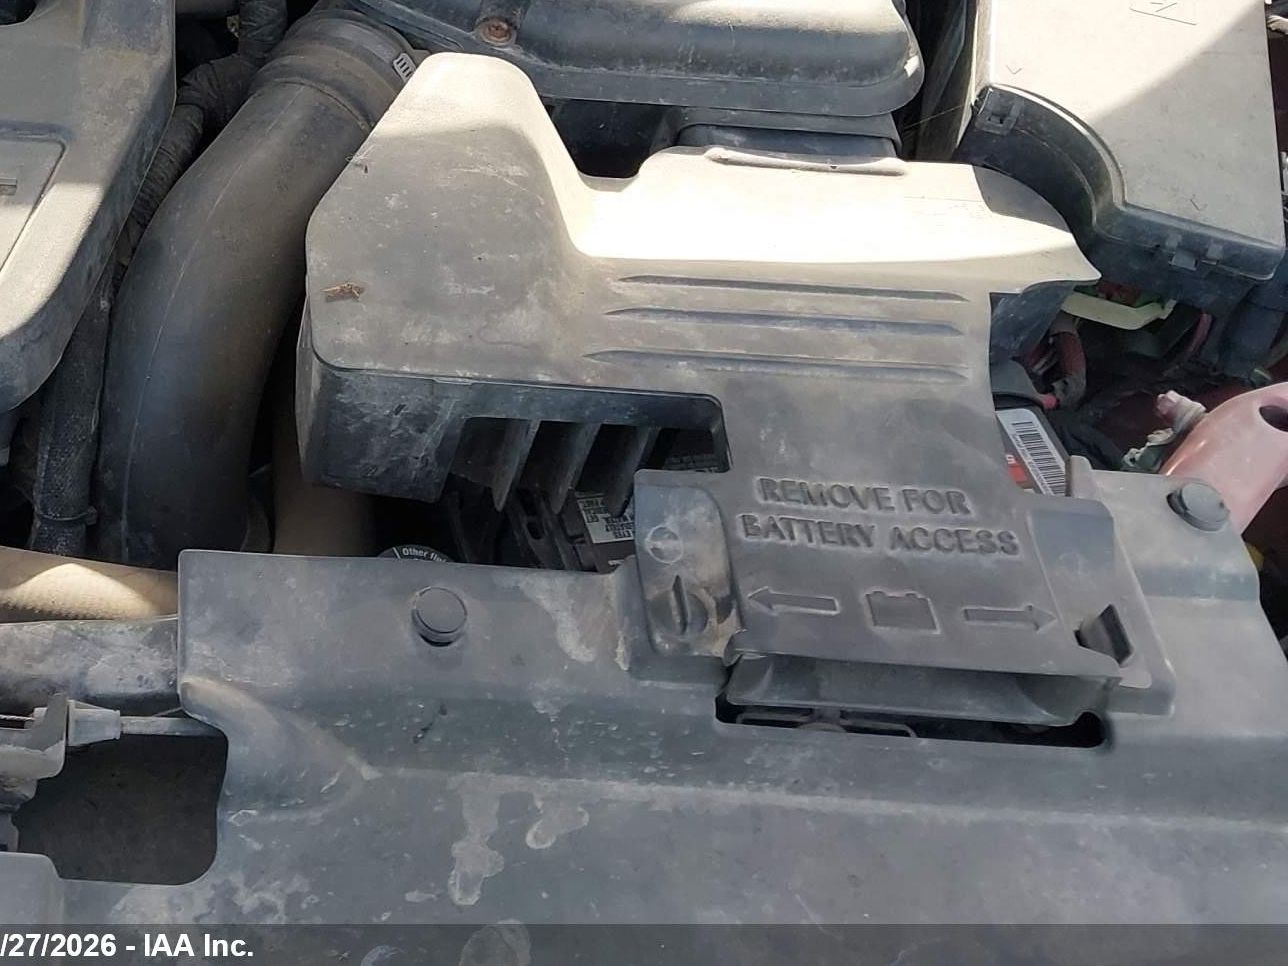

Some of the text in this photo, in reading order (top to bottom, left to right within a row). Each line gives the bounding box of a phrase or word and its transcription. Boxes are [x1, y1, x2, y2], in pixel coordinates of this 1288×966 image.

[755, 476, 972, 518] REMOVE FOR
[402, 547, 429, 558] Other
[736, 513, 1021, 558] BATTERY ACCESS
